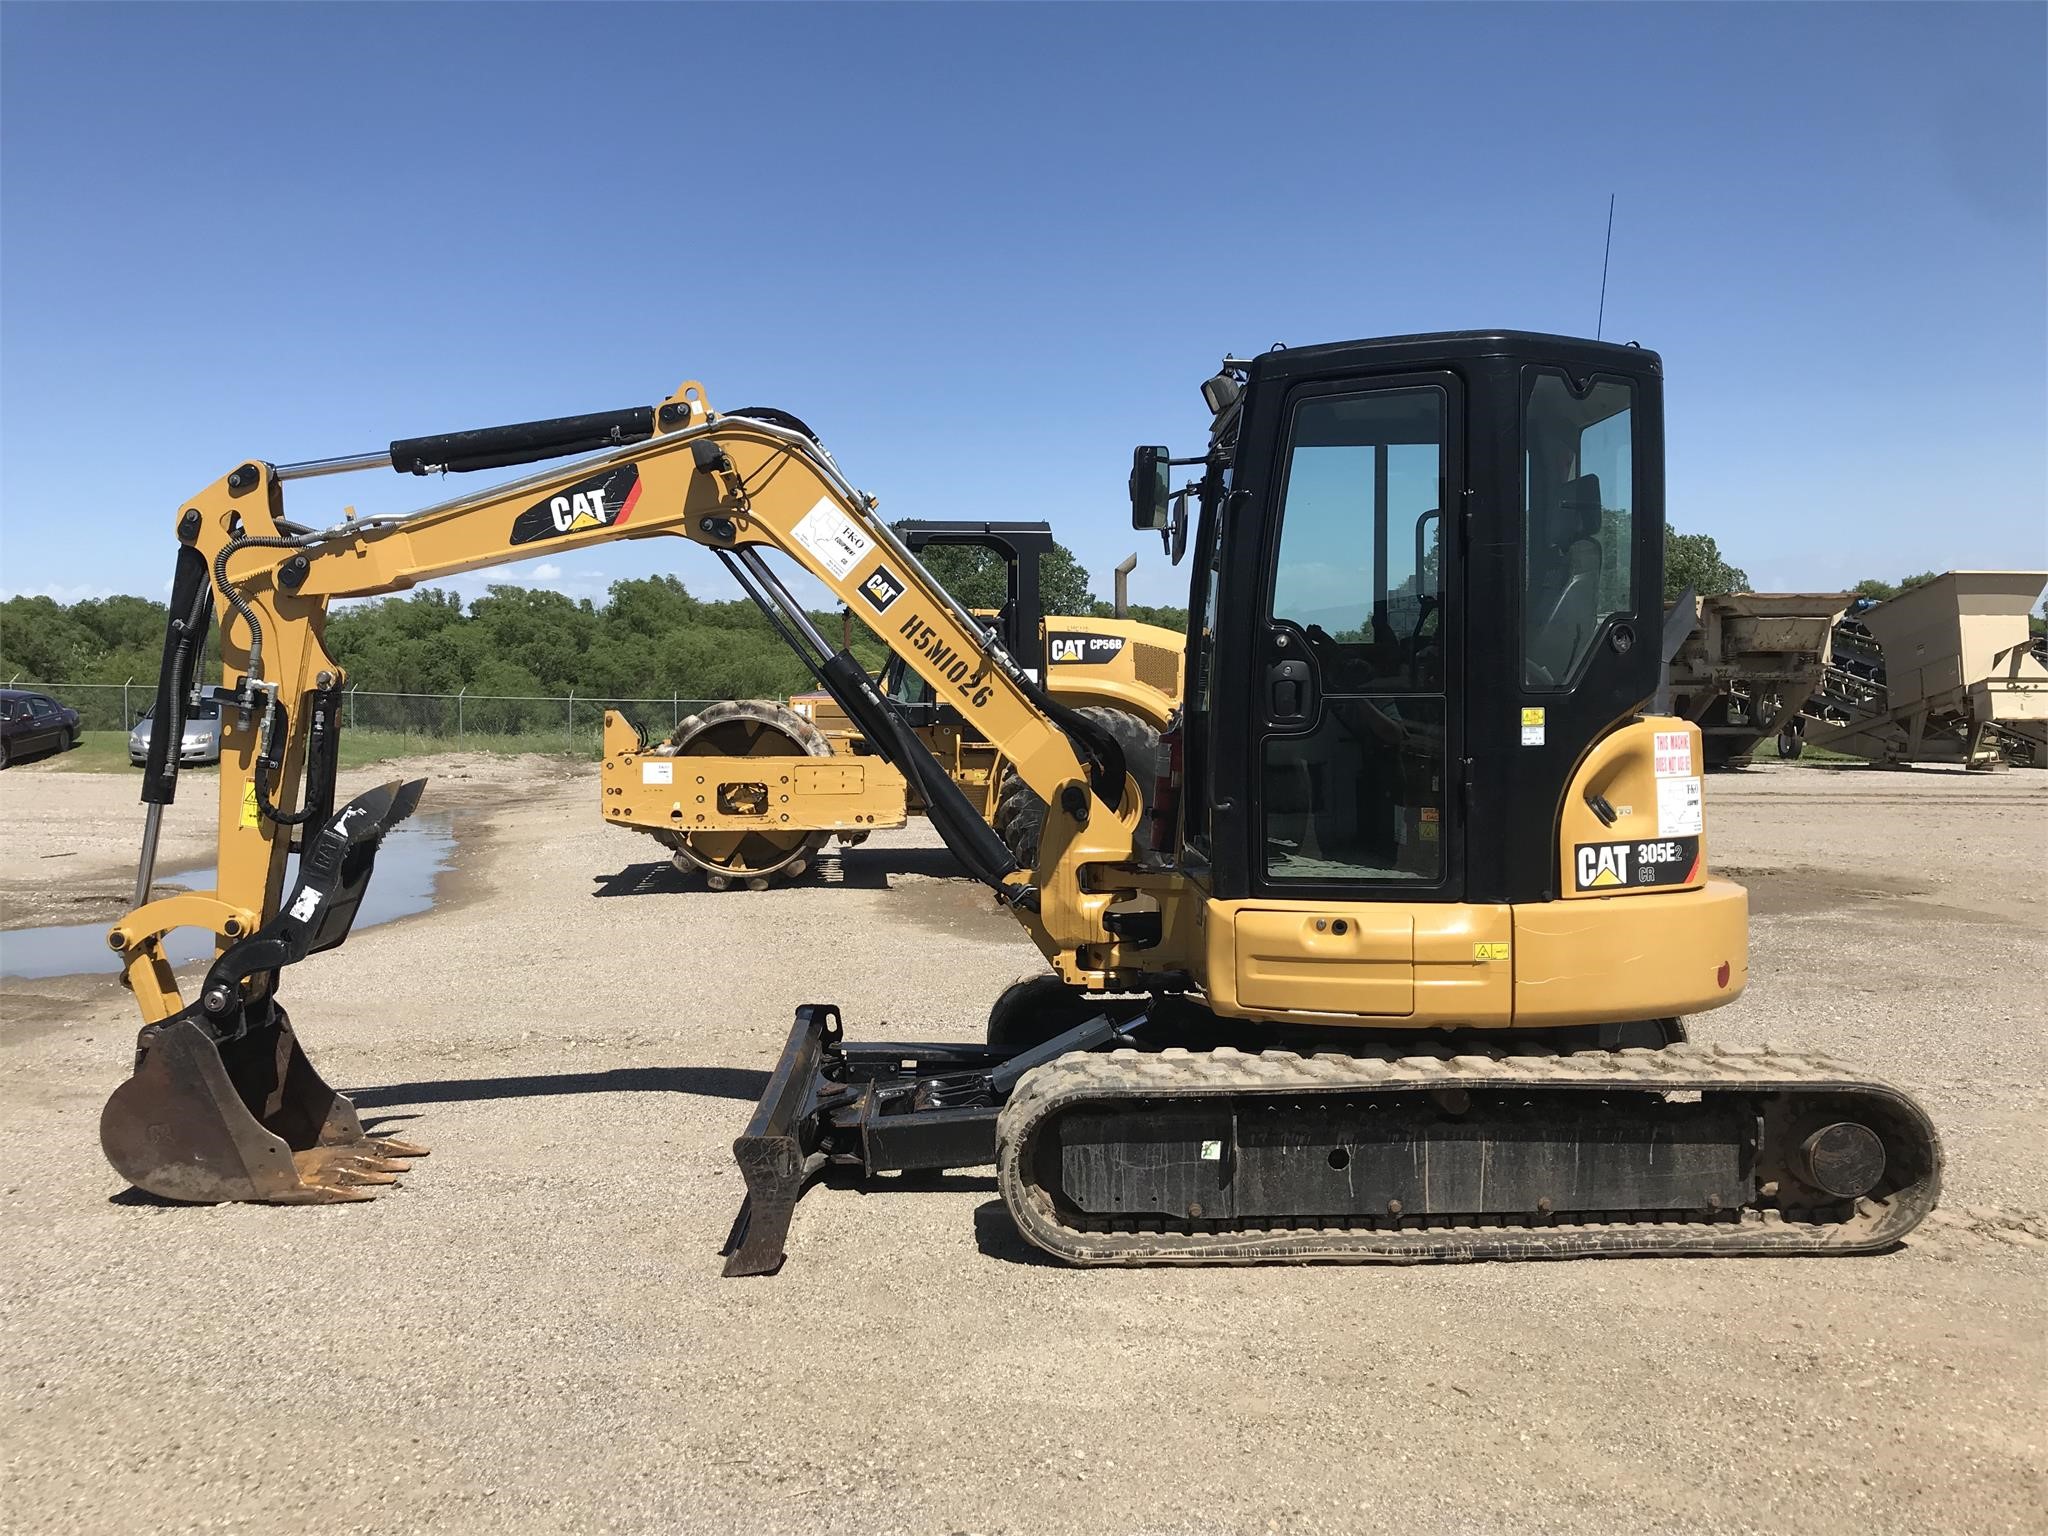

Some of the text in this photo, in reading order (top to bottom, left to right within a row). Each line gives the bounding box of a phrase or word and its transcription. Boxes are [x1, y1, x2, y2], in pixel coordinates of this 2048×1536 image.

[550, 488, 607, 532] CAT
[834, 536, 856, 556] EQUIPMENT
[866, 573, 897, 603] CAT
[1051, 638, 1122, 661] CAT CP56B
[1656, 735, 1668, 750] THIS
[1578, 842, 1683, 887] CAT 305E2
[1638, 867, 1656, 883] CR
